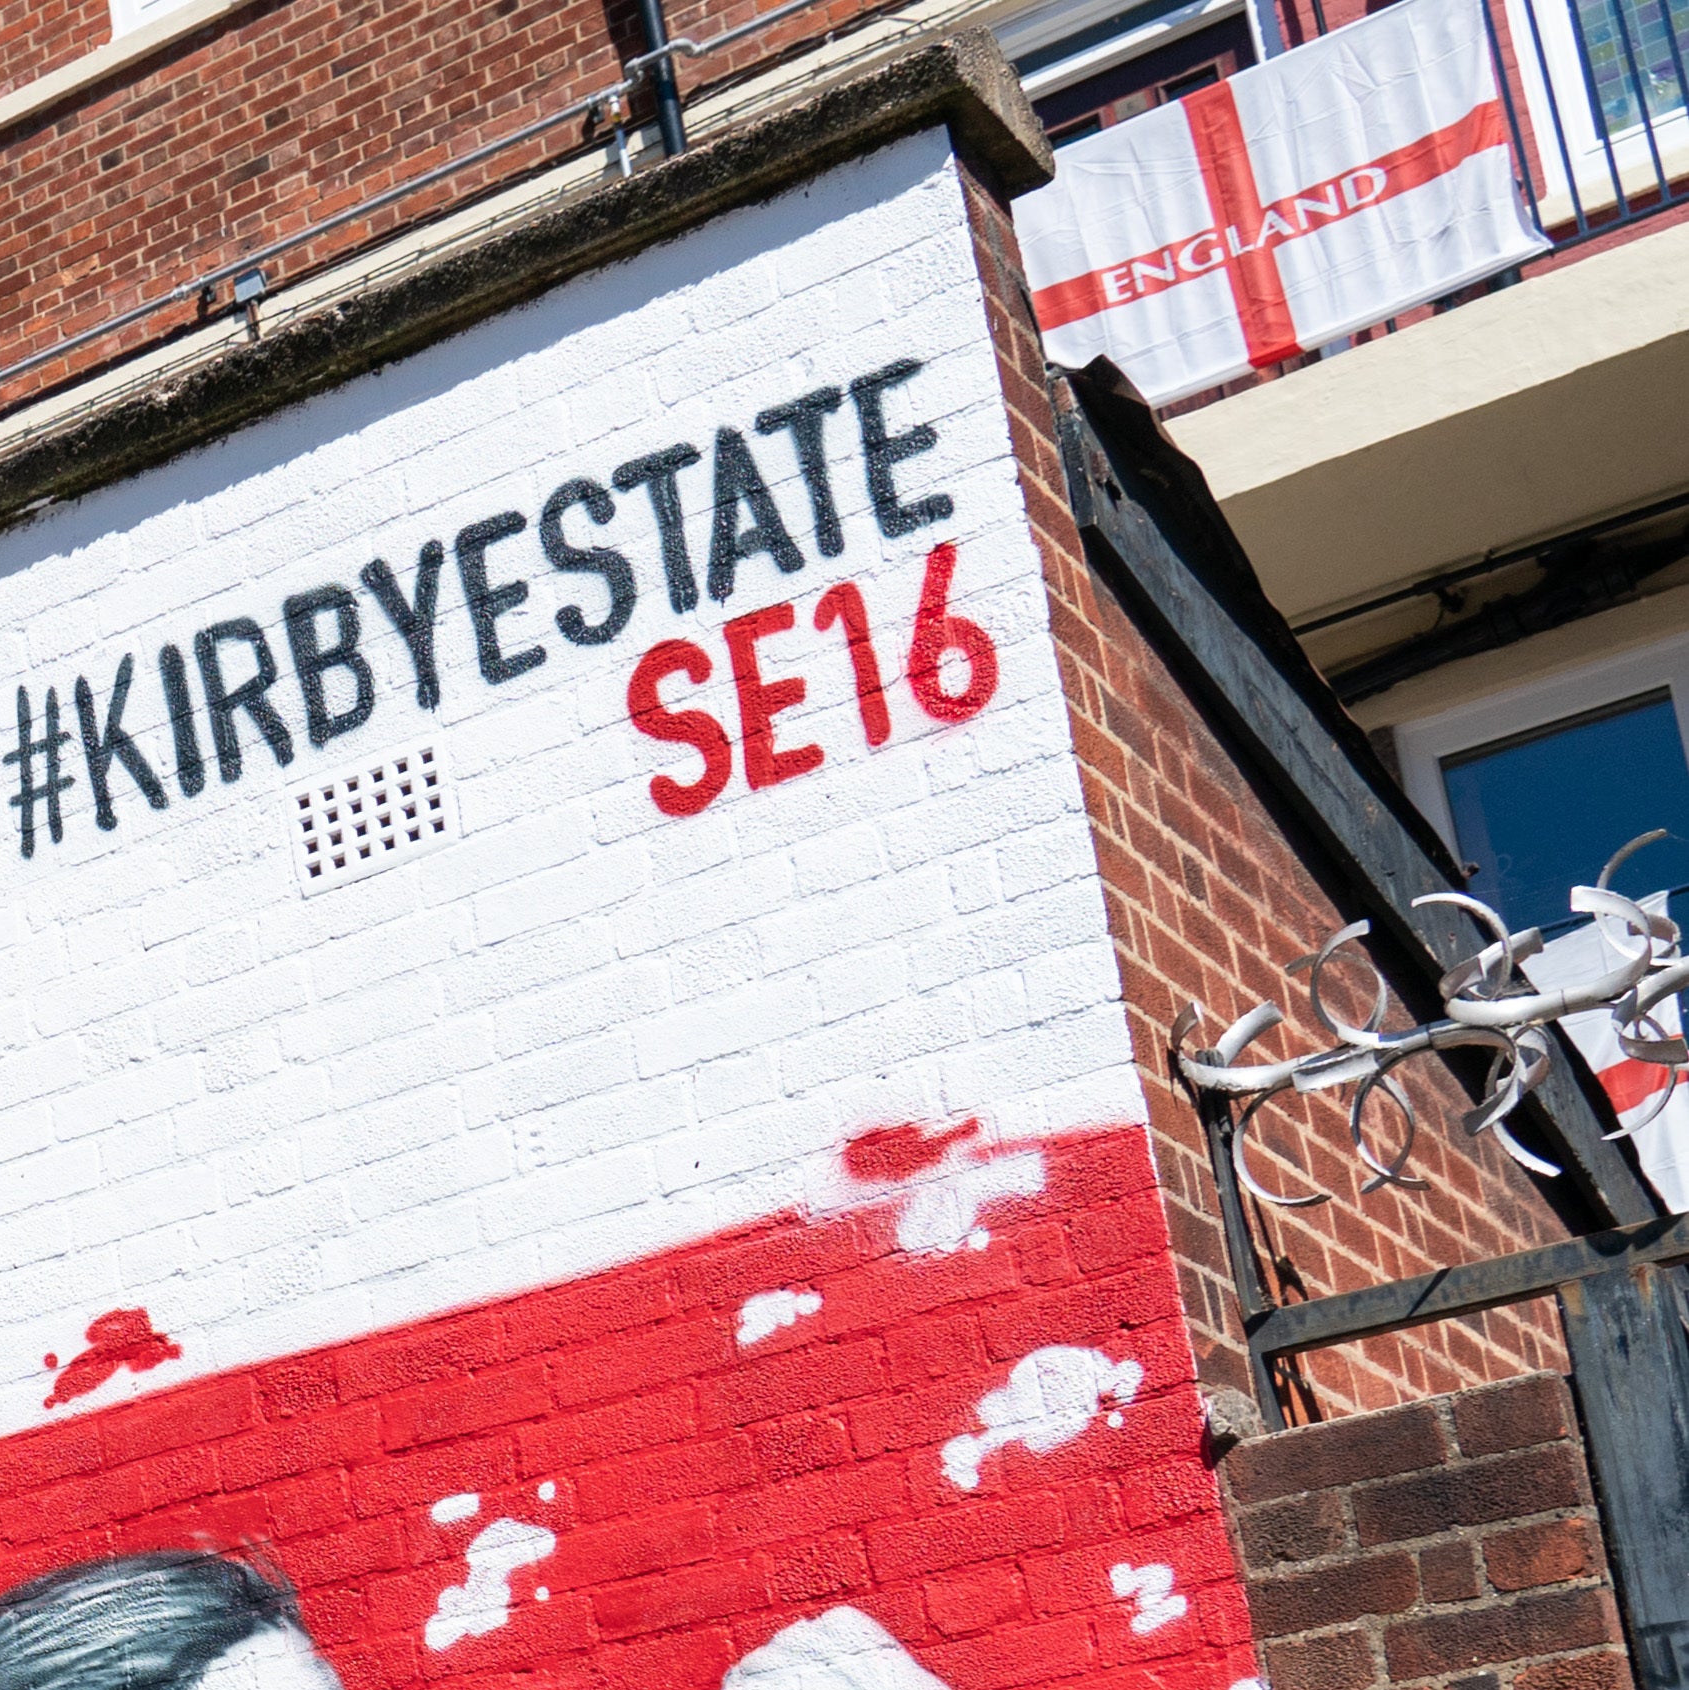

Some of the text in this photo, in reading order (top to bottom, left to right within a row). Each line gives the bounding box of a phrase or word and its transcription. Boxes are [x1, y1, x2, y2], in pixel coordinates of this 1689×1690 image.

[1101, 165, 1388, 306] ENGLAND
[2, 357, 955, 859] #KIRBYESTATE
[625, 540, 1000, 817] SE16
